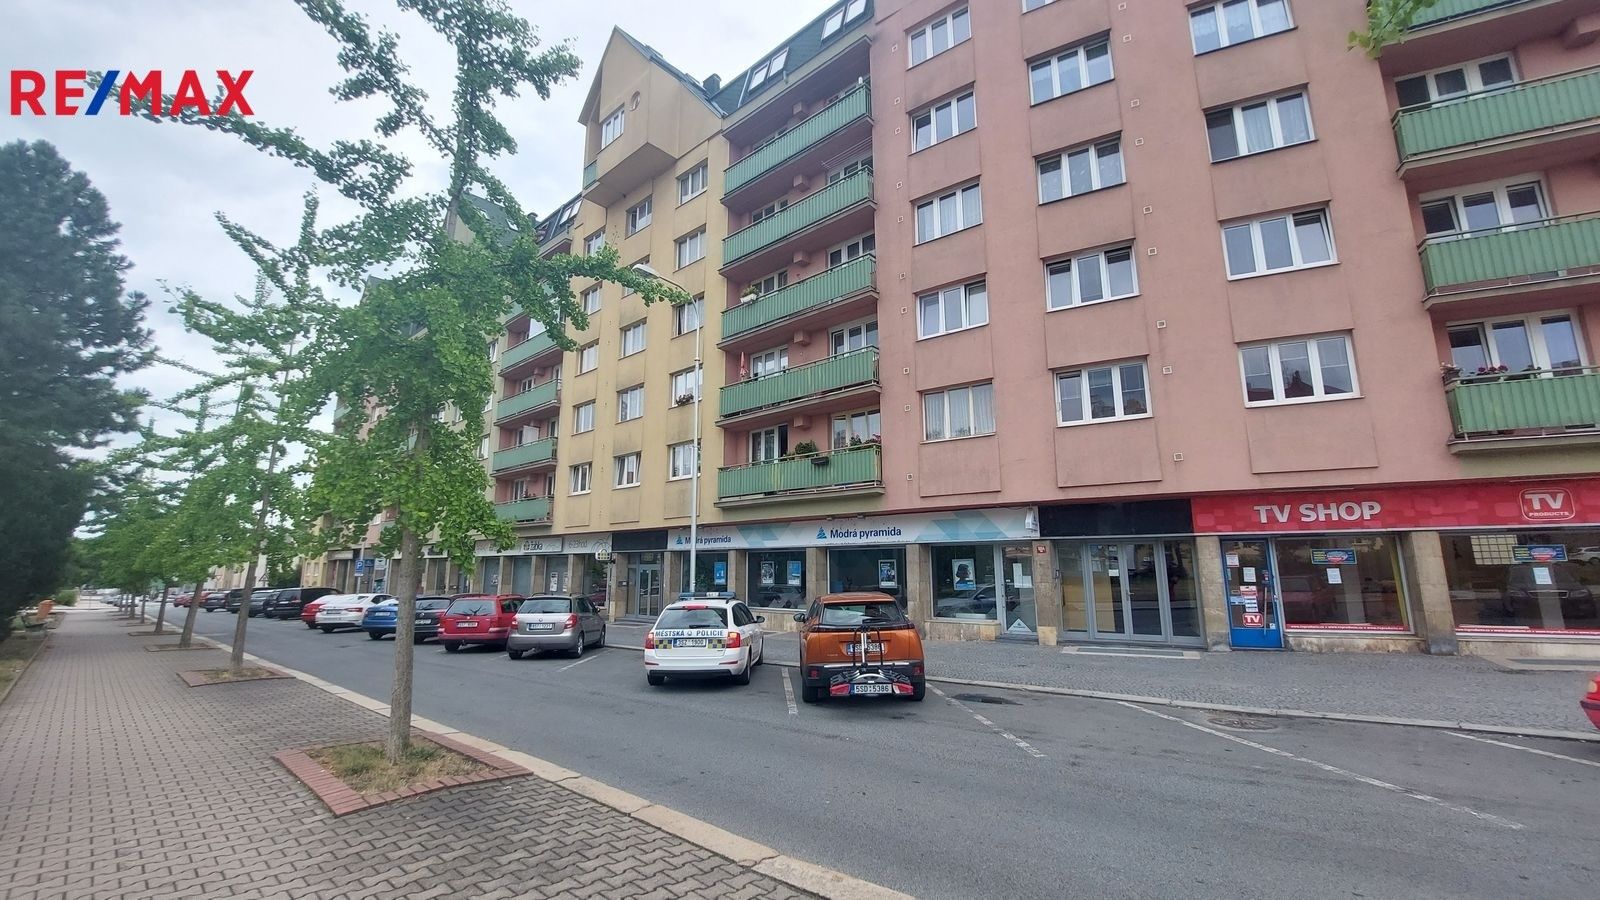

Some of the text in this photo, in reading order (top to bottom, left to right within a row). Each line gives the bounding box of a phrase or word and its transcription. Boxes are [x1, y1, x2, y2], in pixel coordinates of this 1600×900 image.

[1525, 493, 1564, 509] TV
[1254, 501, 1382, 524] TV SHOP
[830, 526, 902, 540] Modrá pyramida
[703, 535, 732, 546] pyramida
[1245, 615, 1261, 623] TV
[696, 629, 724, 637] POLICIE
[856, 684, 890, 693] 5SD 5386
